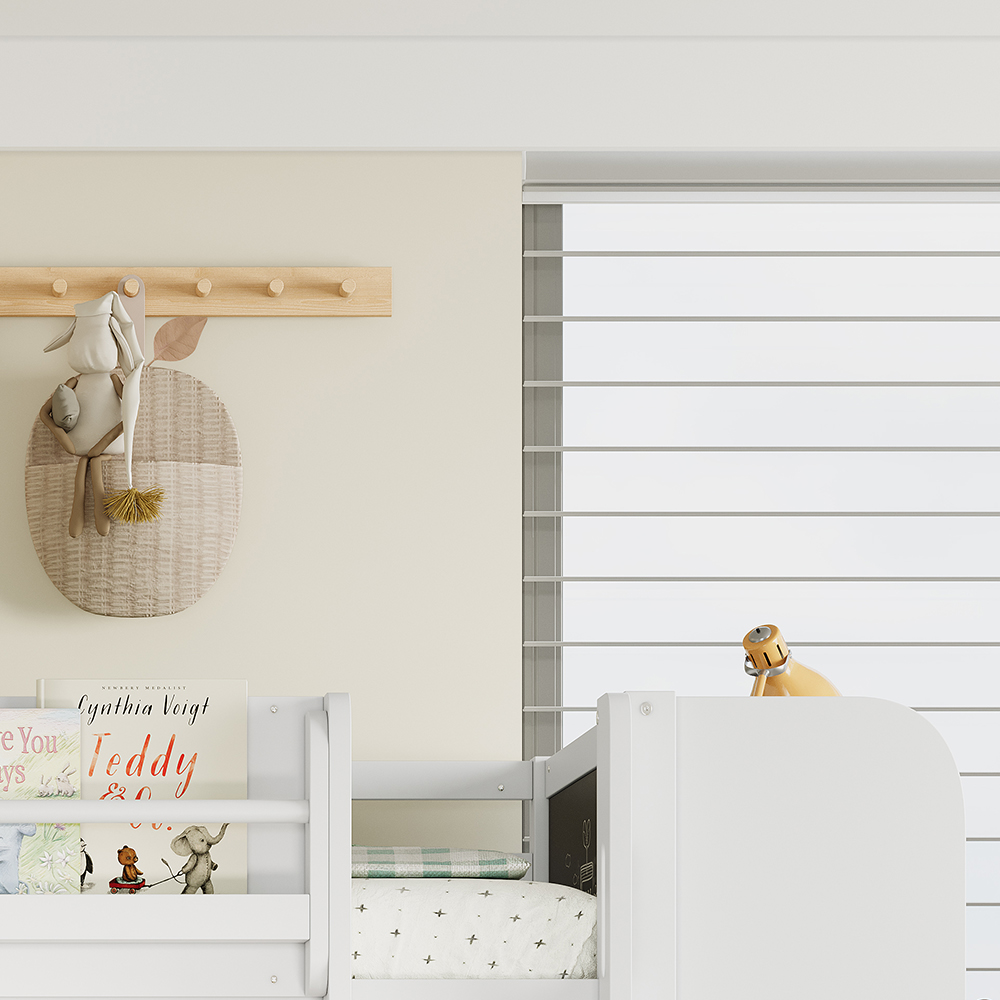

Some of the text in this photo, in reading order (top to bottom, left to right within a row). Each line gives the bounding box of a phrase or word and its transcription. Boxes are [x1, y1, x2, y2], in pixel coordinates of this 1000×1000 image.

[77, 694, 210, 726] Cynthia Voigt
[17, 726, 58, 754] You
[88, 732, 198, 799] Teddy
